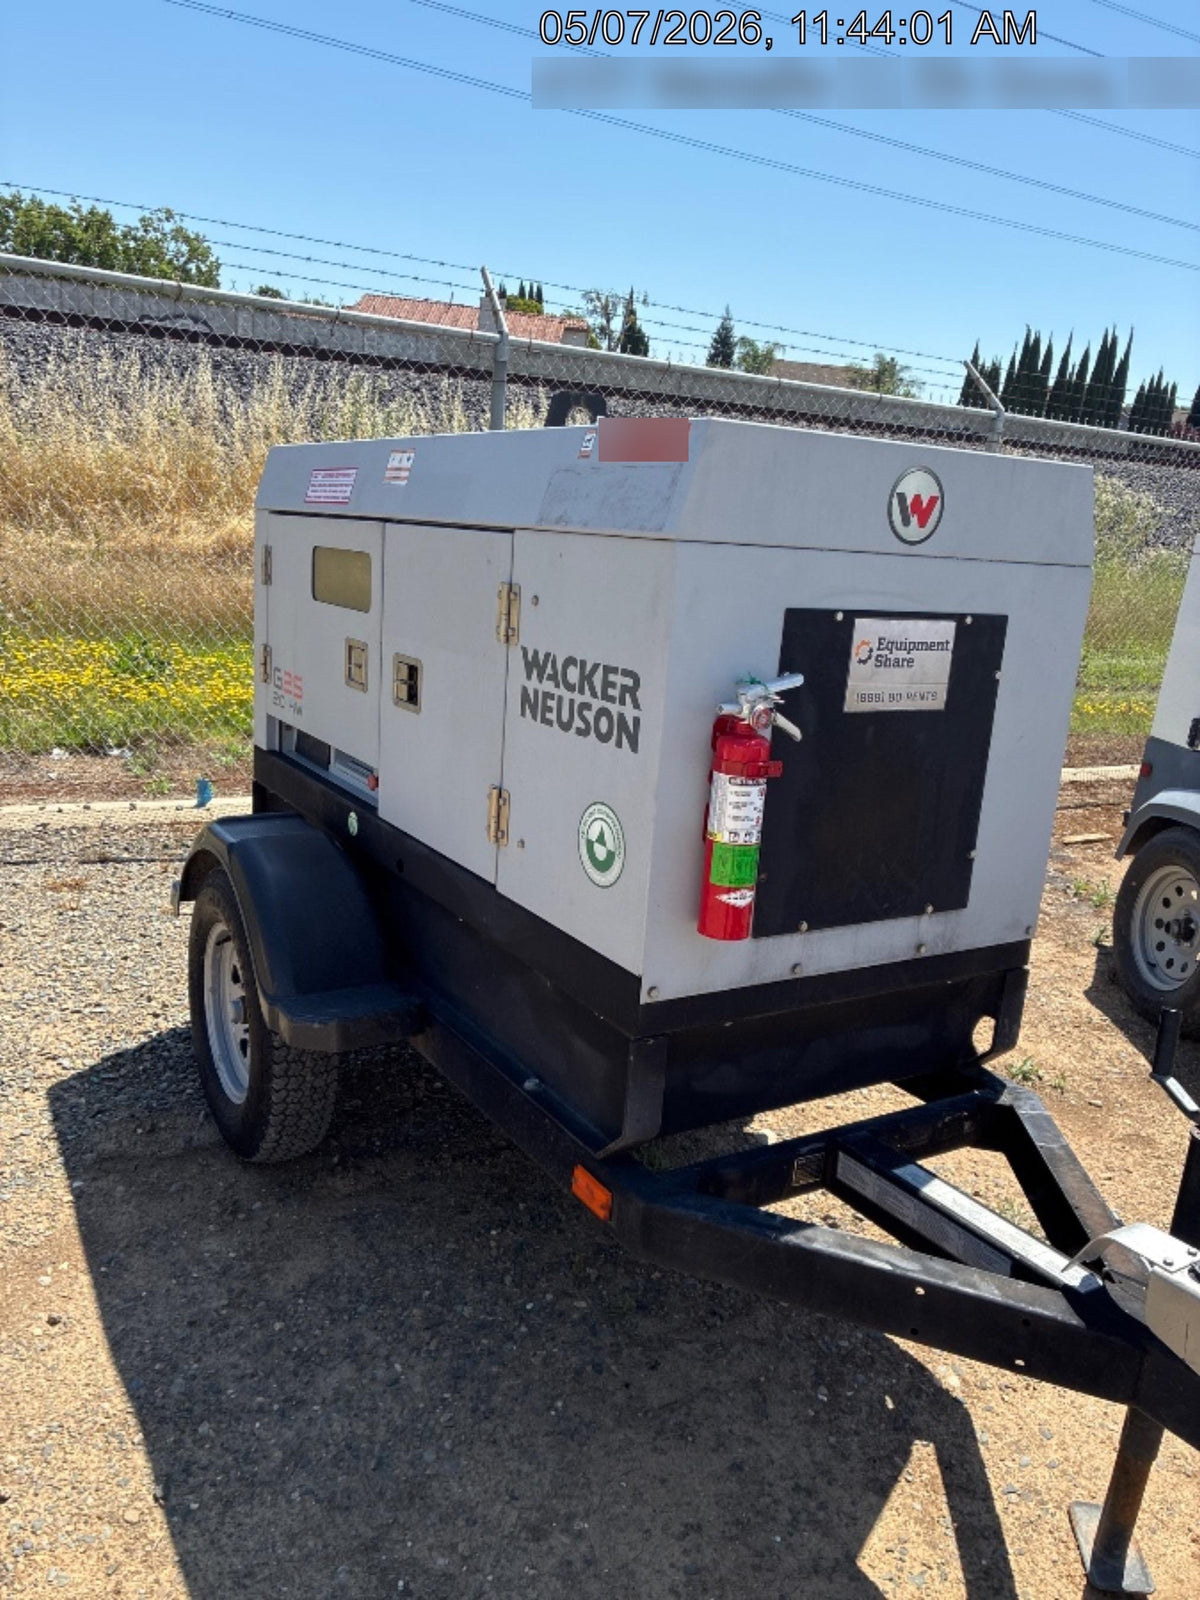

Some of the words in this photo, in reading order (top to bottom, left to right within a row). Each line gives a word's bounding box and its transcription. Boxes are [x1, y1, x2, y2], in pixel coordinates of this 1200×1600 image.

[874, 654, 915, 668] Share
[876, 637, 951, 655] Equipment
[520, 644, 643, 711] WACKER
[520, 684, 642, 754] NEUSON
